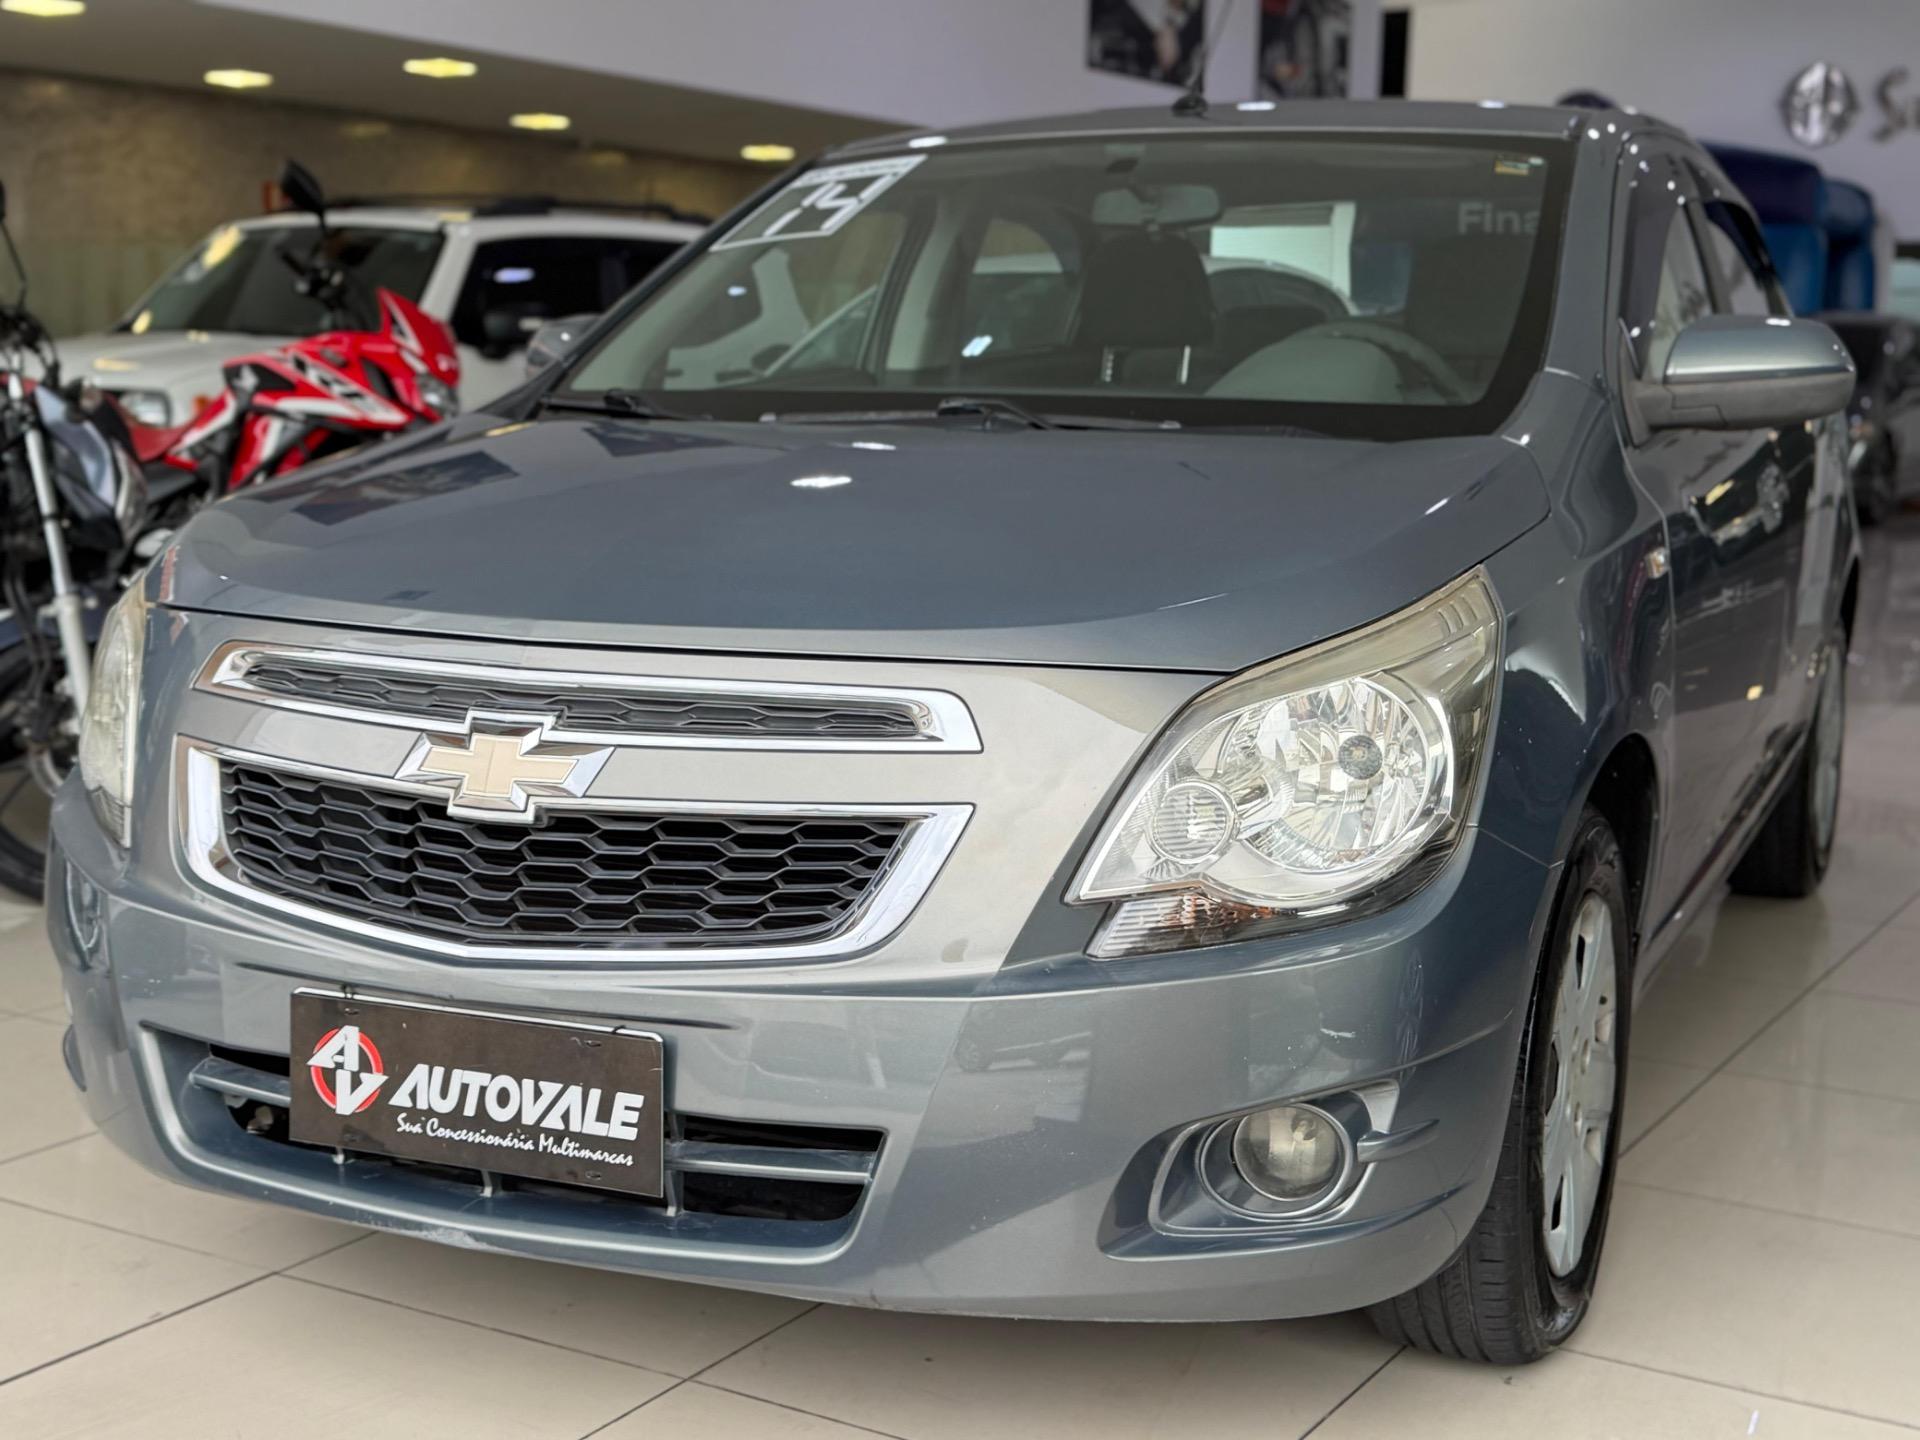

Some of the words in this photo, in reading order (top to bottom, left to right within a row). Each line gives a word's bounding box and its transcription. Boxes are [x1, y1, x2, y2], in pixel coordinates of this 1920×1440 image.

[388, 1063, 645, 1141] AUTOVALE
[426, 1117, 535, 1151] Concessionária
[538, 1133, 635, 1167] Multimarcas
